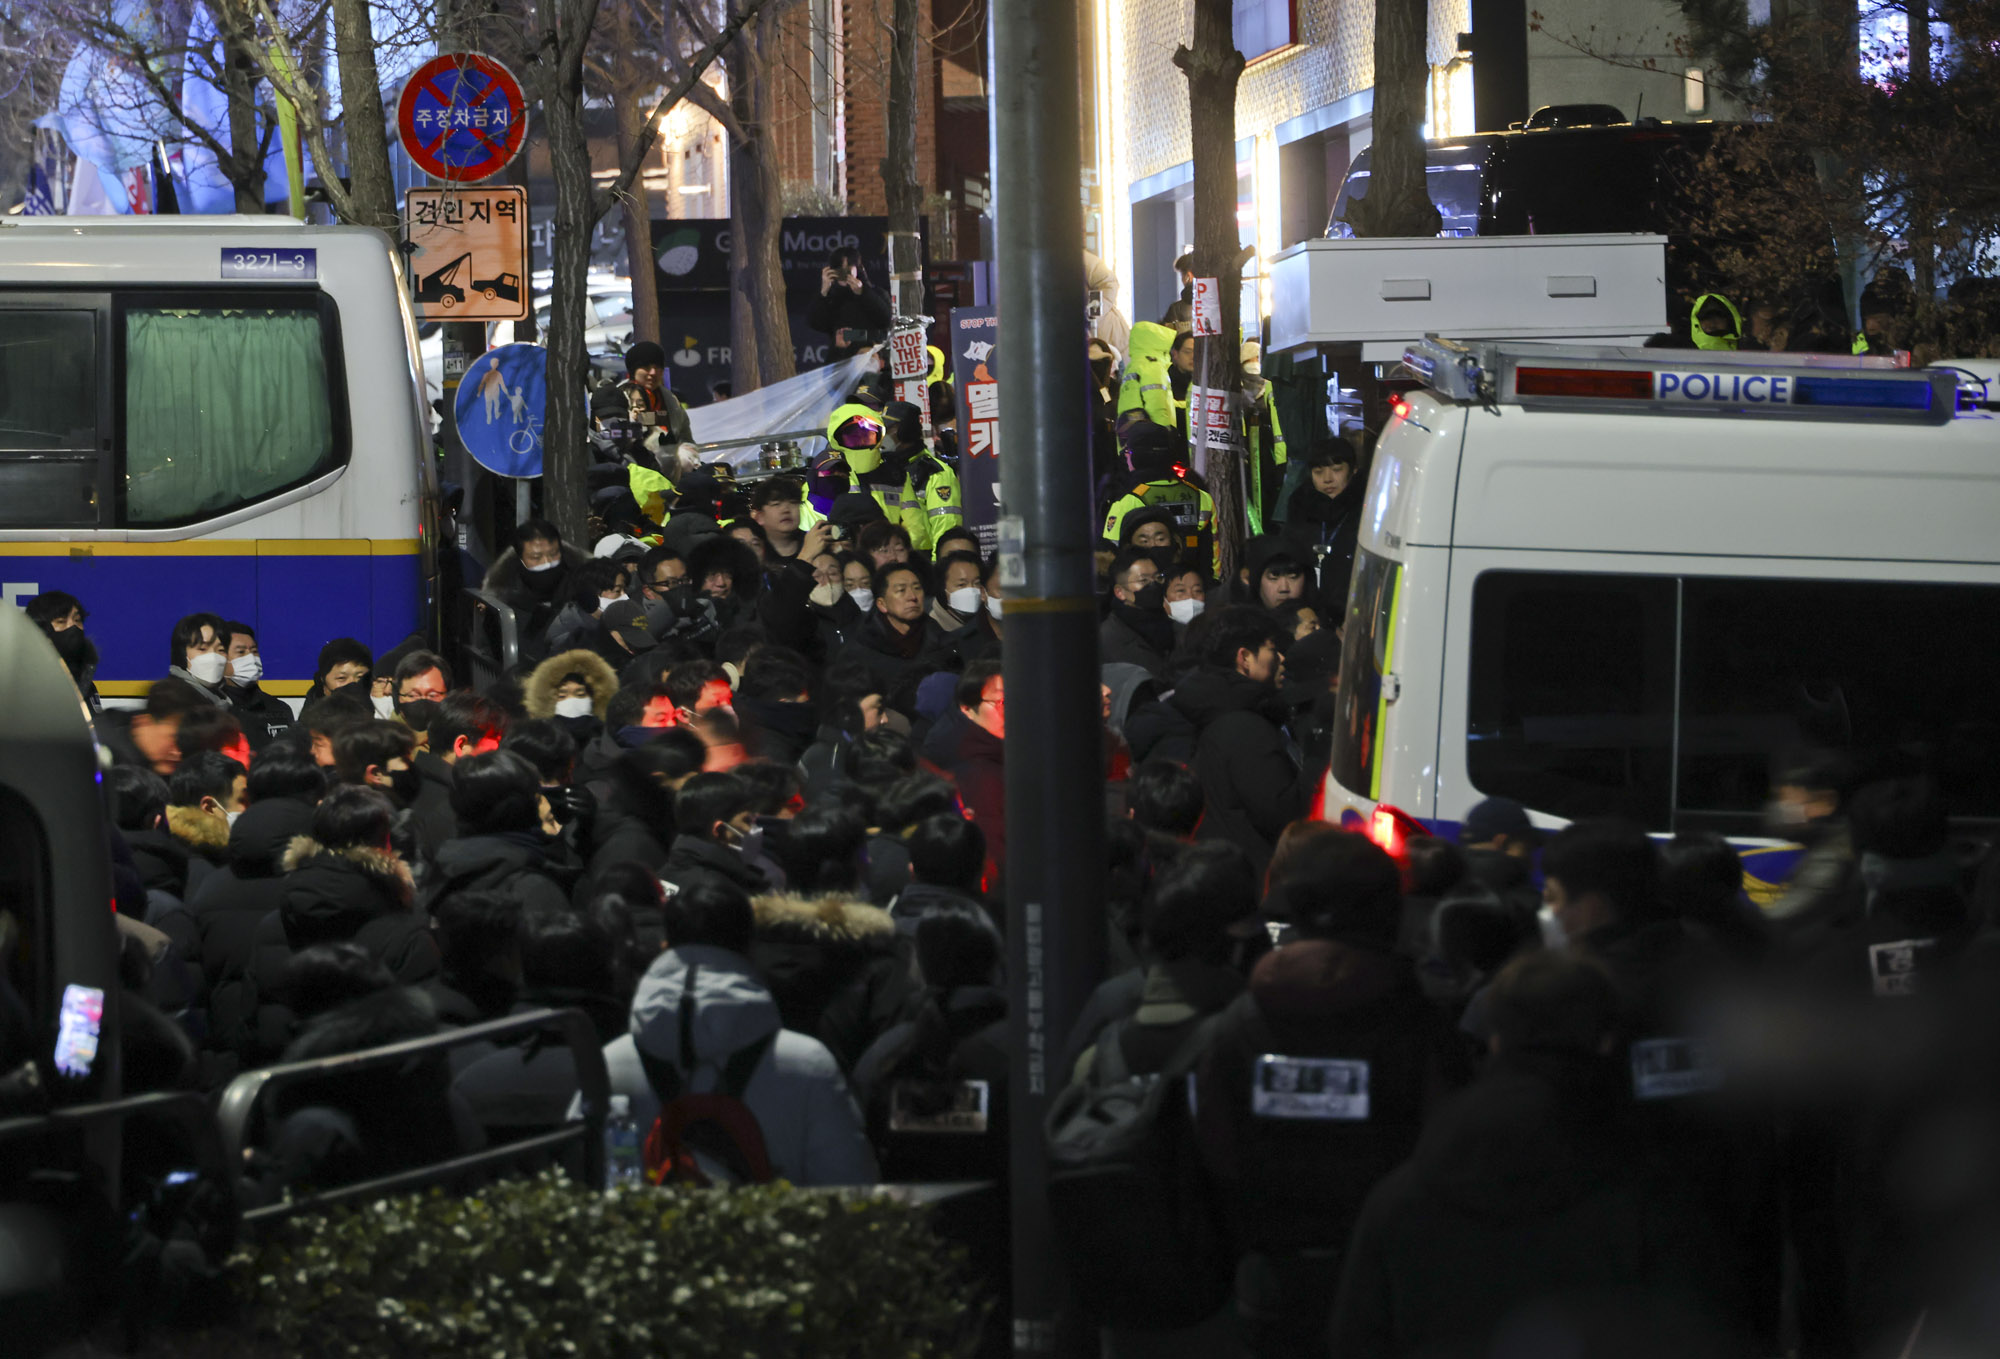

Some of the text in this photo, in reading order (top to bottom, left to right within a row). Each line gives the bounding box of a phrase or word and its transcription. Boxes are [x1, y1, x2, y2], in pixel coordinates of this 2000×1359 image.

[416, 107, 508, 129] 주정차금지
[415, 198, 517, 225] 견인지역
[784, 231, 860, 253] Made
[233, 252, 306, 273] 32기-3
[960, 317, 985, 329] STOP
[892, 331, 923, 350] STOP
[896, 345, 921, 362] THE
[893, 359, 927, 376] STEA
[1659, 373, 1788, 403] POLICE
